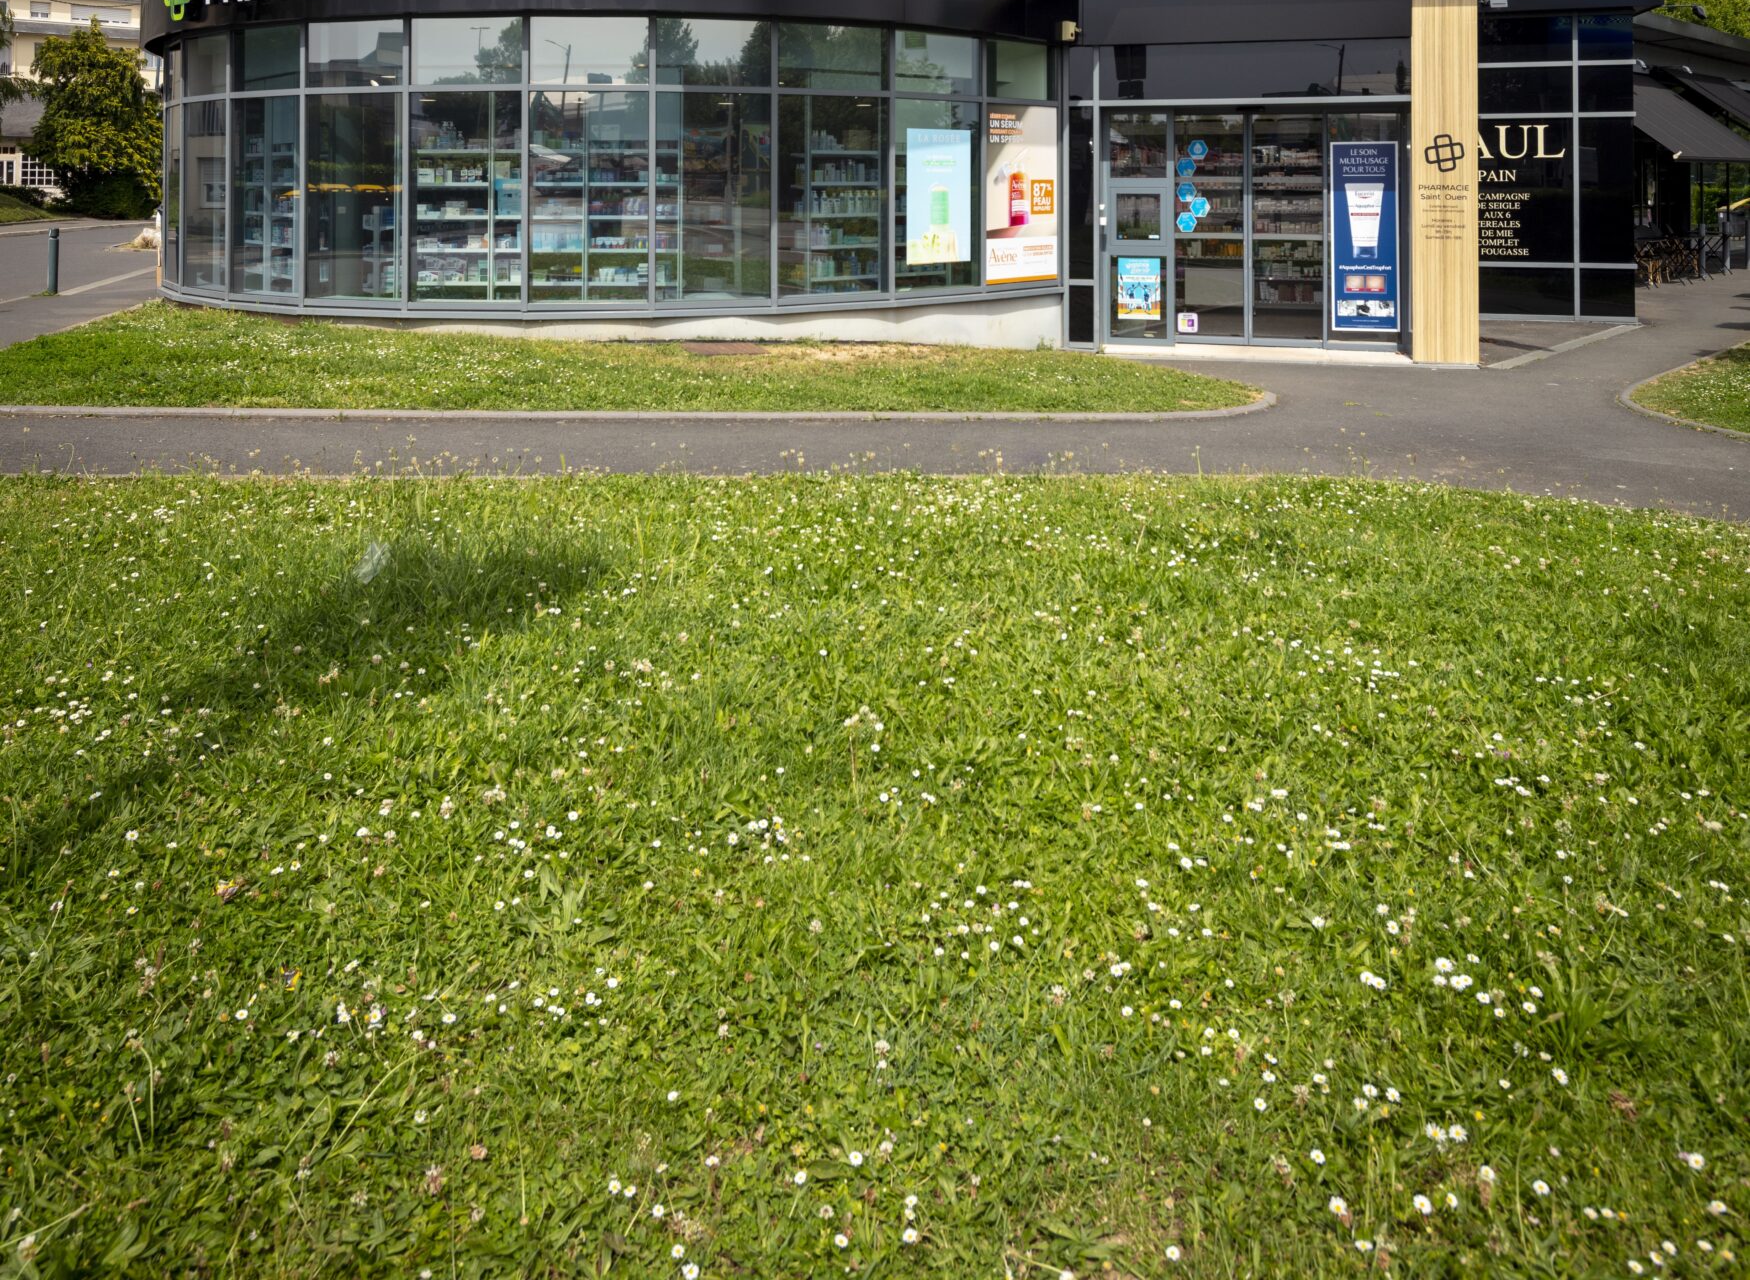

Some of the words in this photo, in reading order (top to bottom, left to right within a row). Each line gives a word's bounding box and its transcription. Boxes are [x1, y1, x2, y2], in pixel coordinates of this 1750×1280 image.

[989, 120, 1000, 128] UN
[989, 135, 1000, 143] UN
[1350, 148, 1358, 156] LE
[1359, 148, 1378, 156] SOIN
[1340, 157, 1389, 165] MULTI-USAGE
[1478, 169, 1517, 182] PAIN
[1418, 184, 1470, 192] PHARMACIE
[1478, 192, 1531, 200] CAMPAGNE
[1488, 202, 1521, 210] SEIGLE
[1484, 211, 1504, 219] AUX
[1505, 211, 1512, 219] 6
[1478, 220, 1521, 228] EREALES
[1481, 229, 1494, 237] DE
[1496, 229, 1514, 237] MIE
[988, 248, 1018, 263] Avène
[1481, 247, 1530, 256] FOUGASSE
